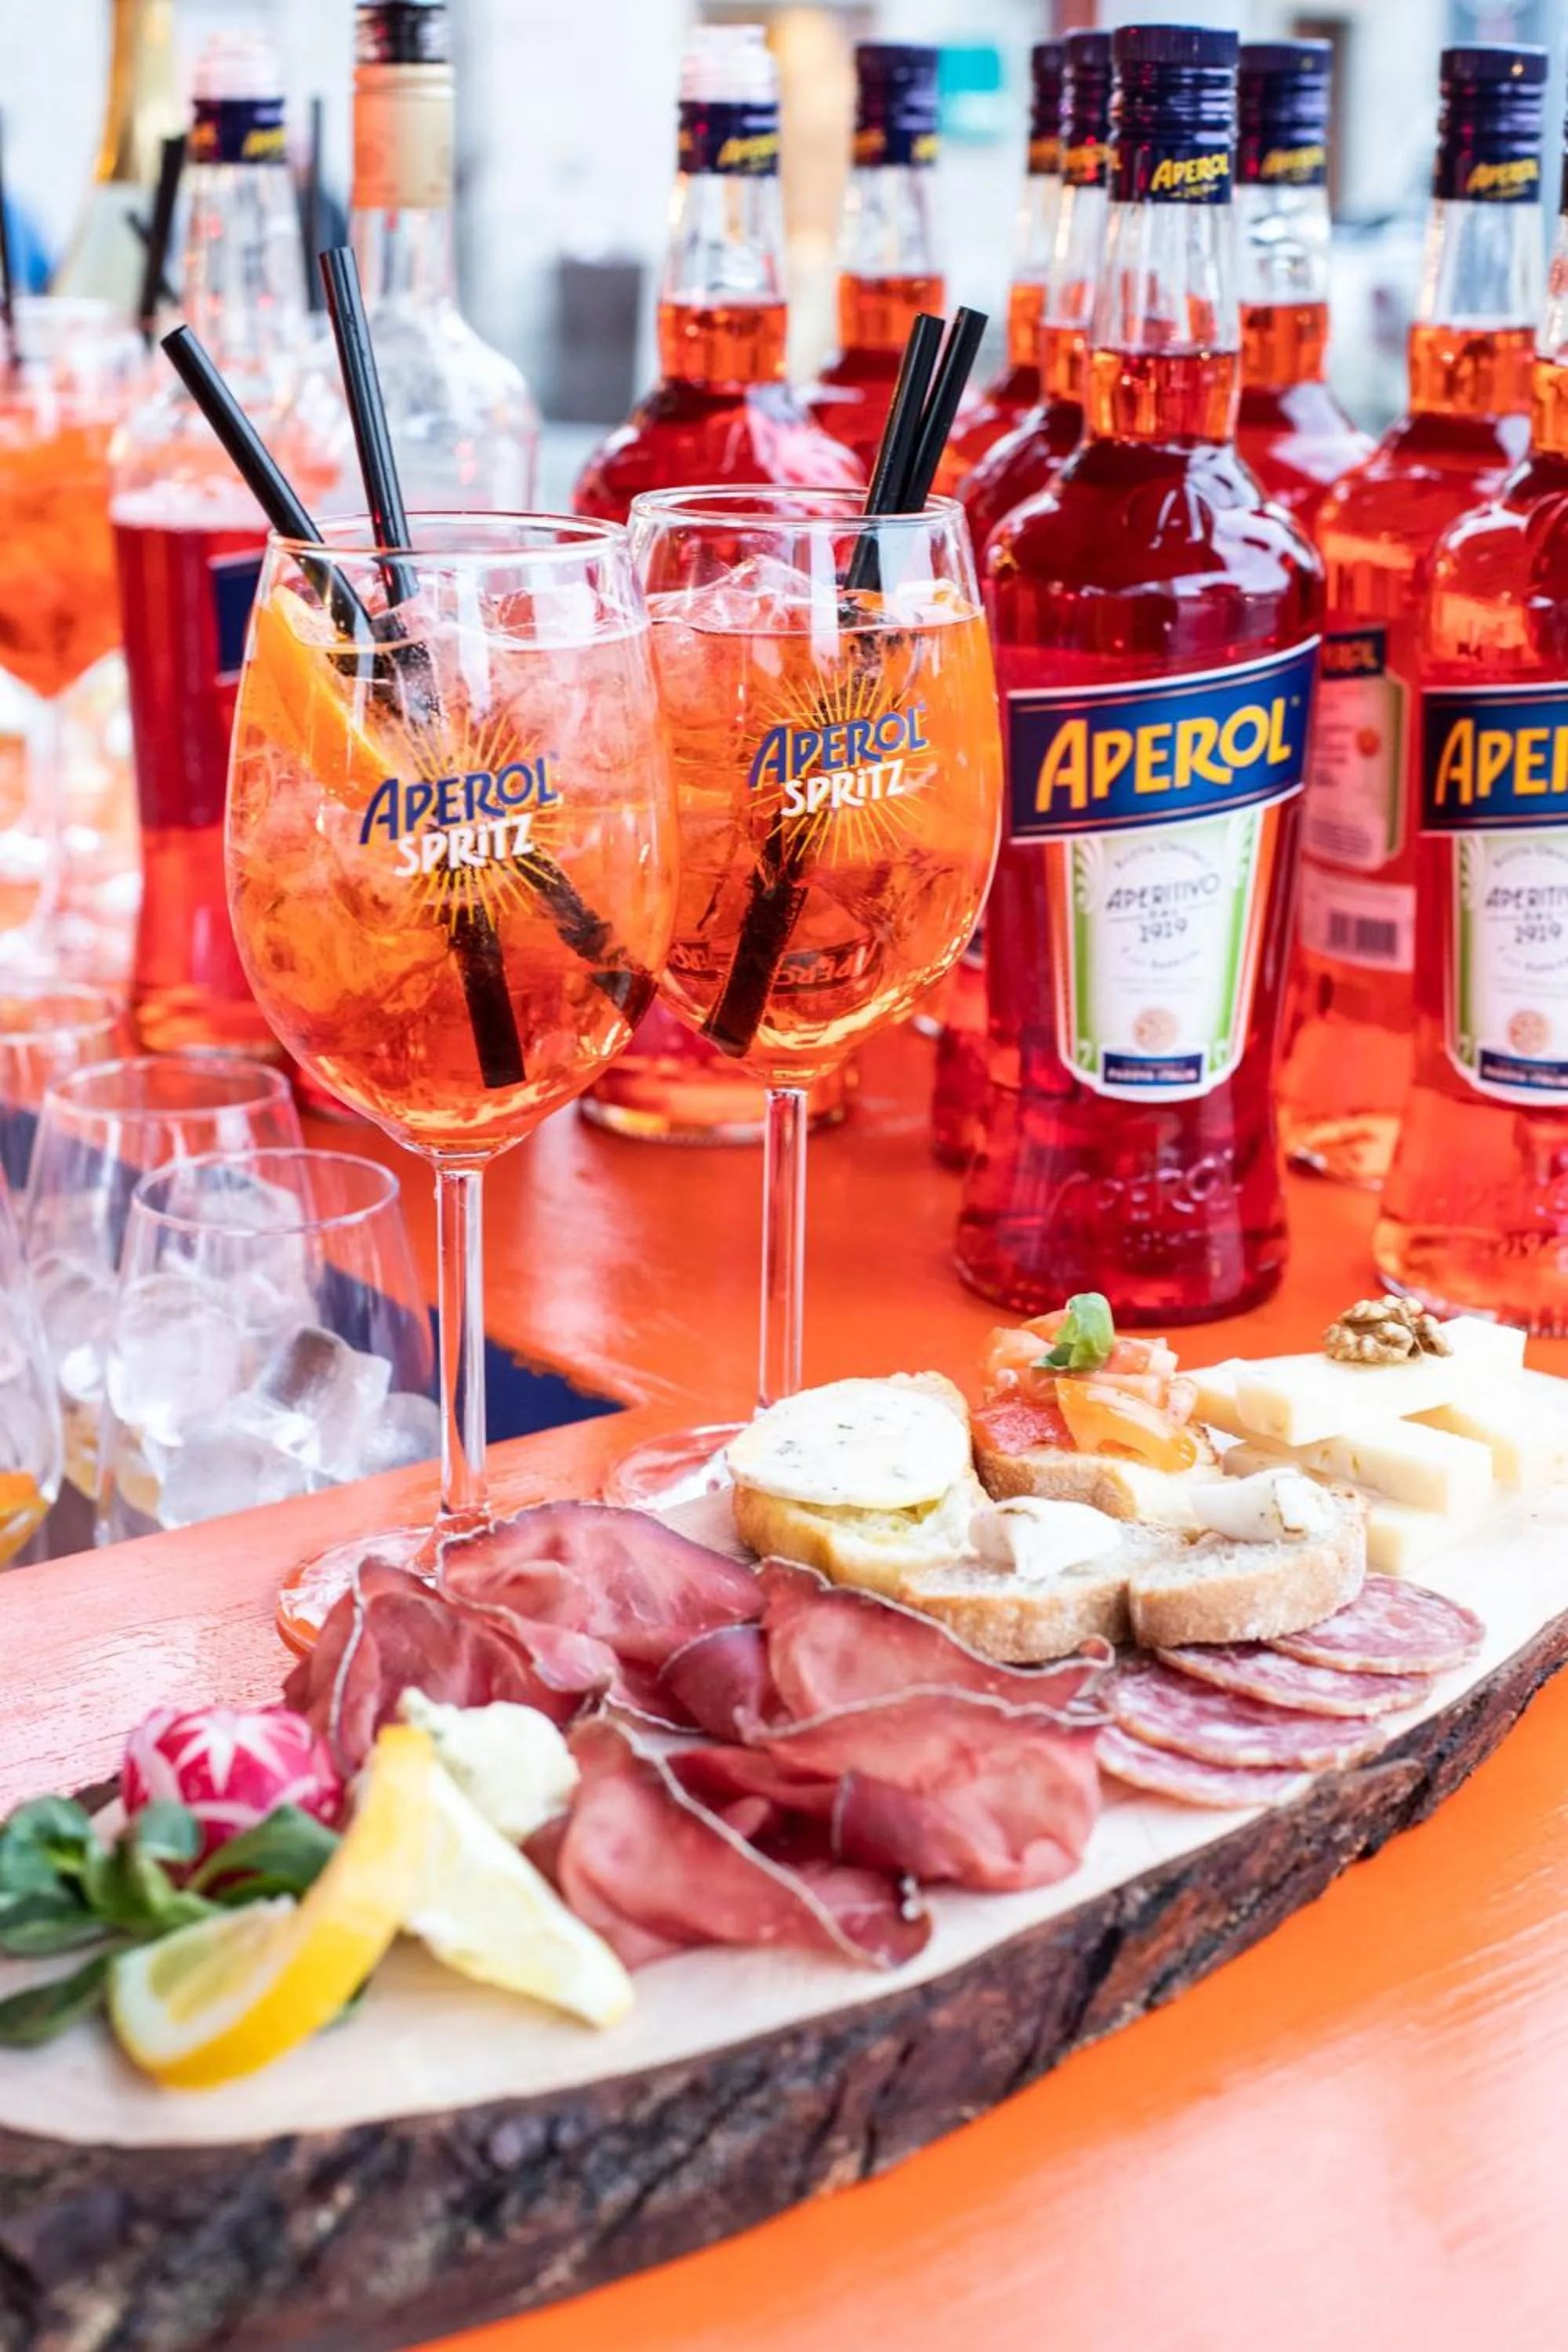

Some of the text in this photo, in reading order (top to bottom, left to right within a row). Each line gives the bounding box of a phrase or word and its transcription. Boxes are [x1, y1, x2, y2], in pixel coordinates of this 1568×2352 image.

[750, 707, 928, 789] APEROL
[1035, 698, 1291, 813] APEROL
[359, 757, 561, 845] APEROL
[1106, 873, 1221, 912] APERITIVO
[1139, 917, 1188, 942] 1919
